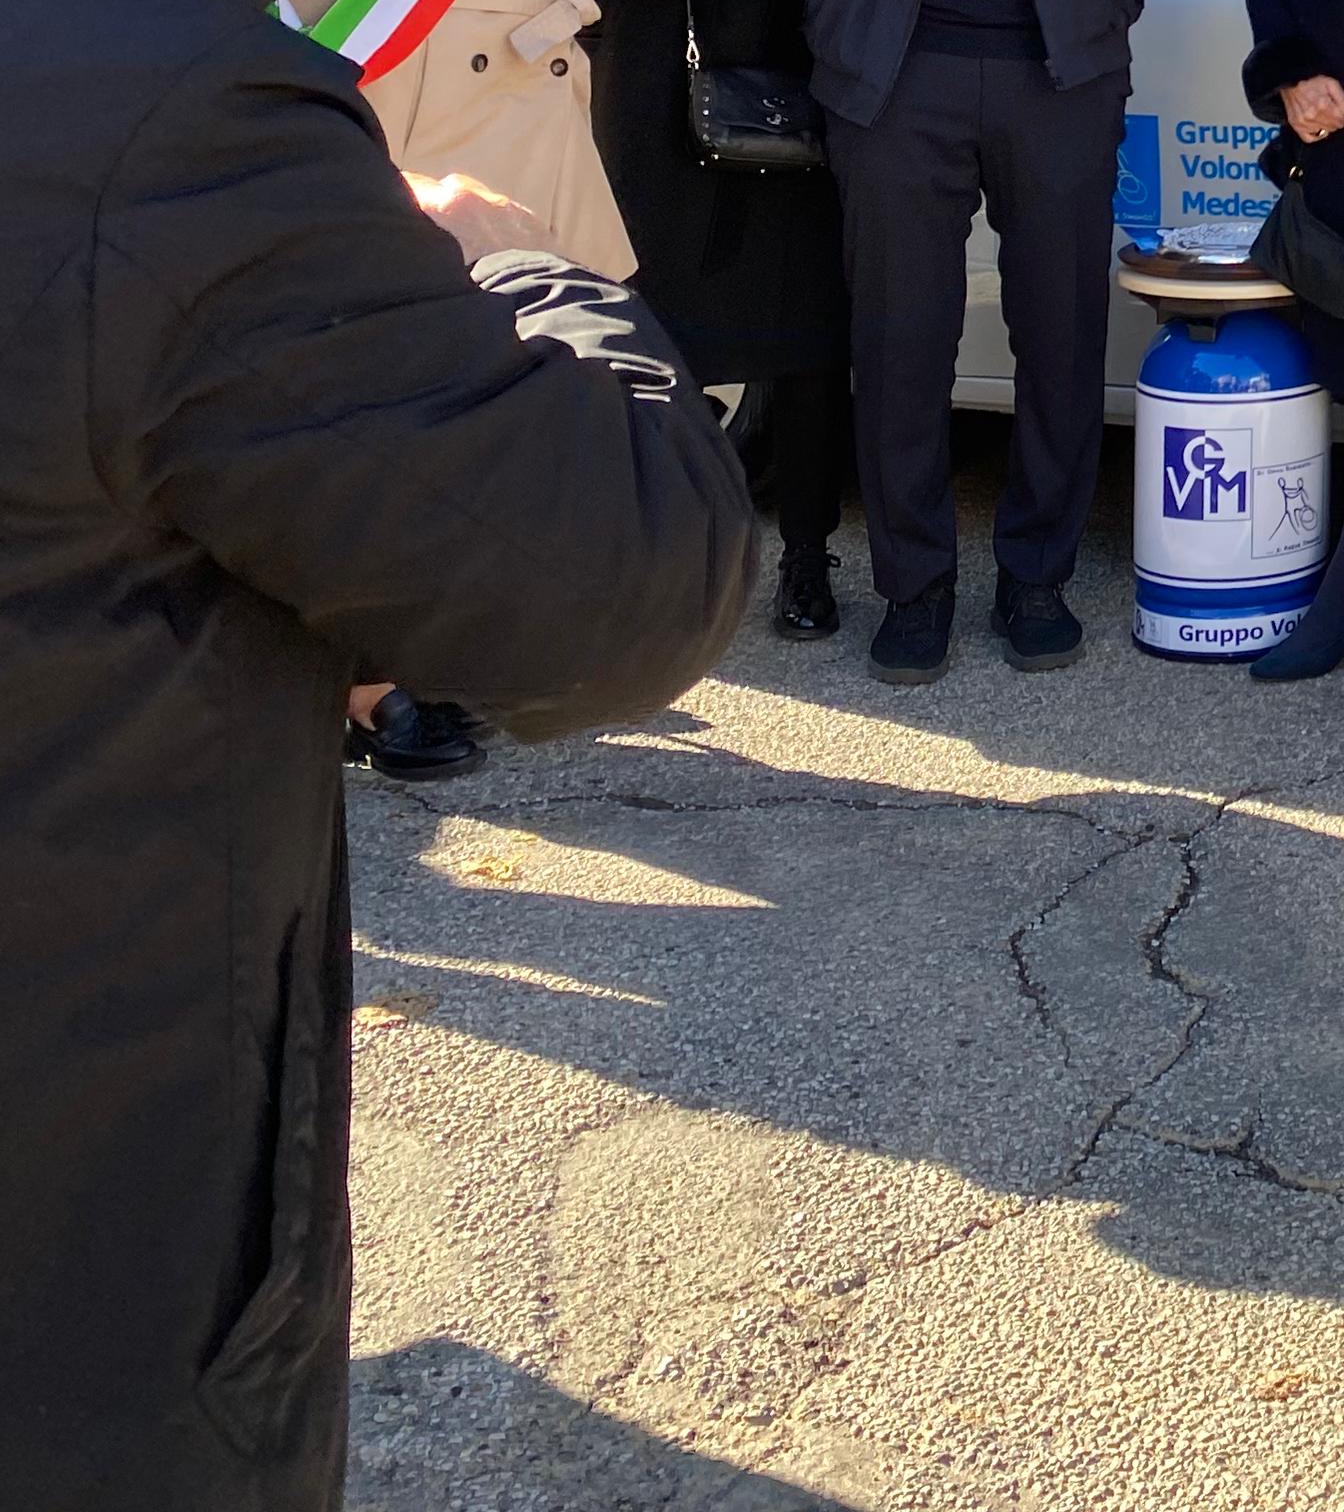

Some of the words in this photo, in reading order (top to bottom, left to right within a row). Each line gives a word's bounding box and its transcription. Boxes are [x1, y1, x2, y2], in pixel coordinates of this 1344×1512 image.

[1180, 154, 1270, 181] Volon
[1182, 190, 1280, 218] Medes
[1179, 625, 1263, 647] Gruppo
